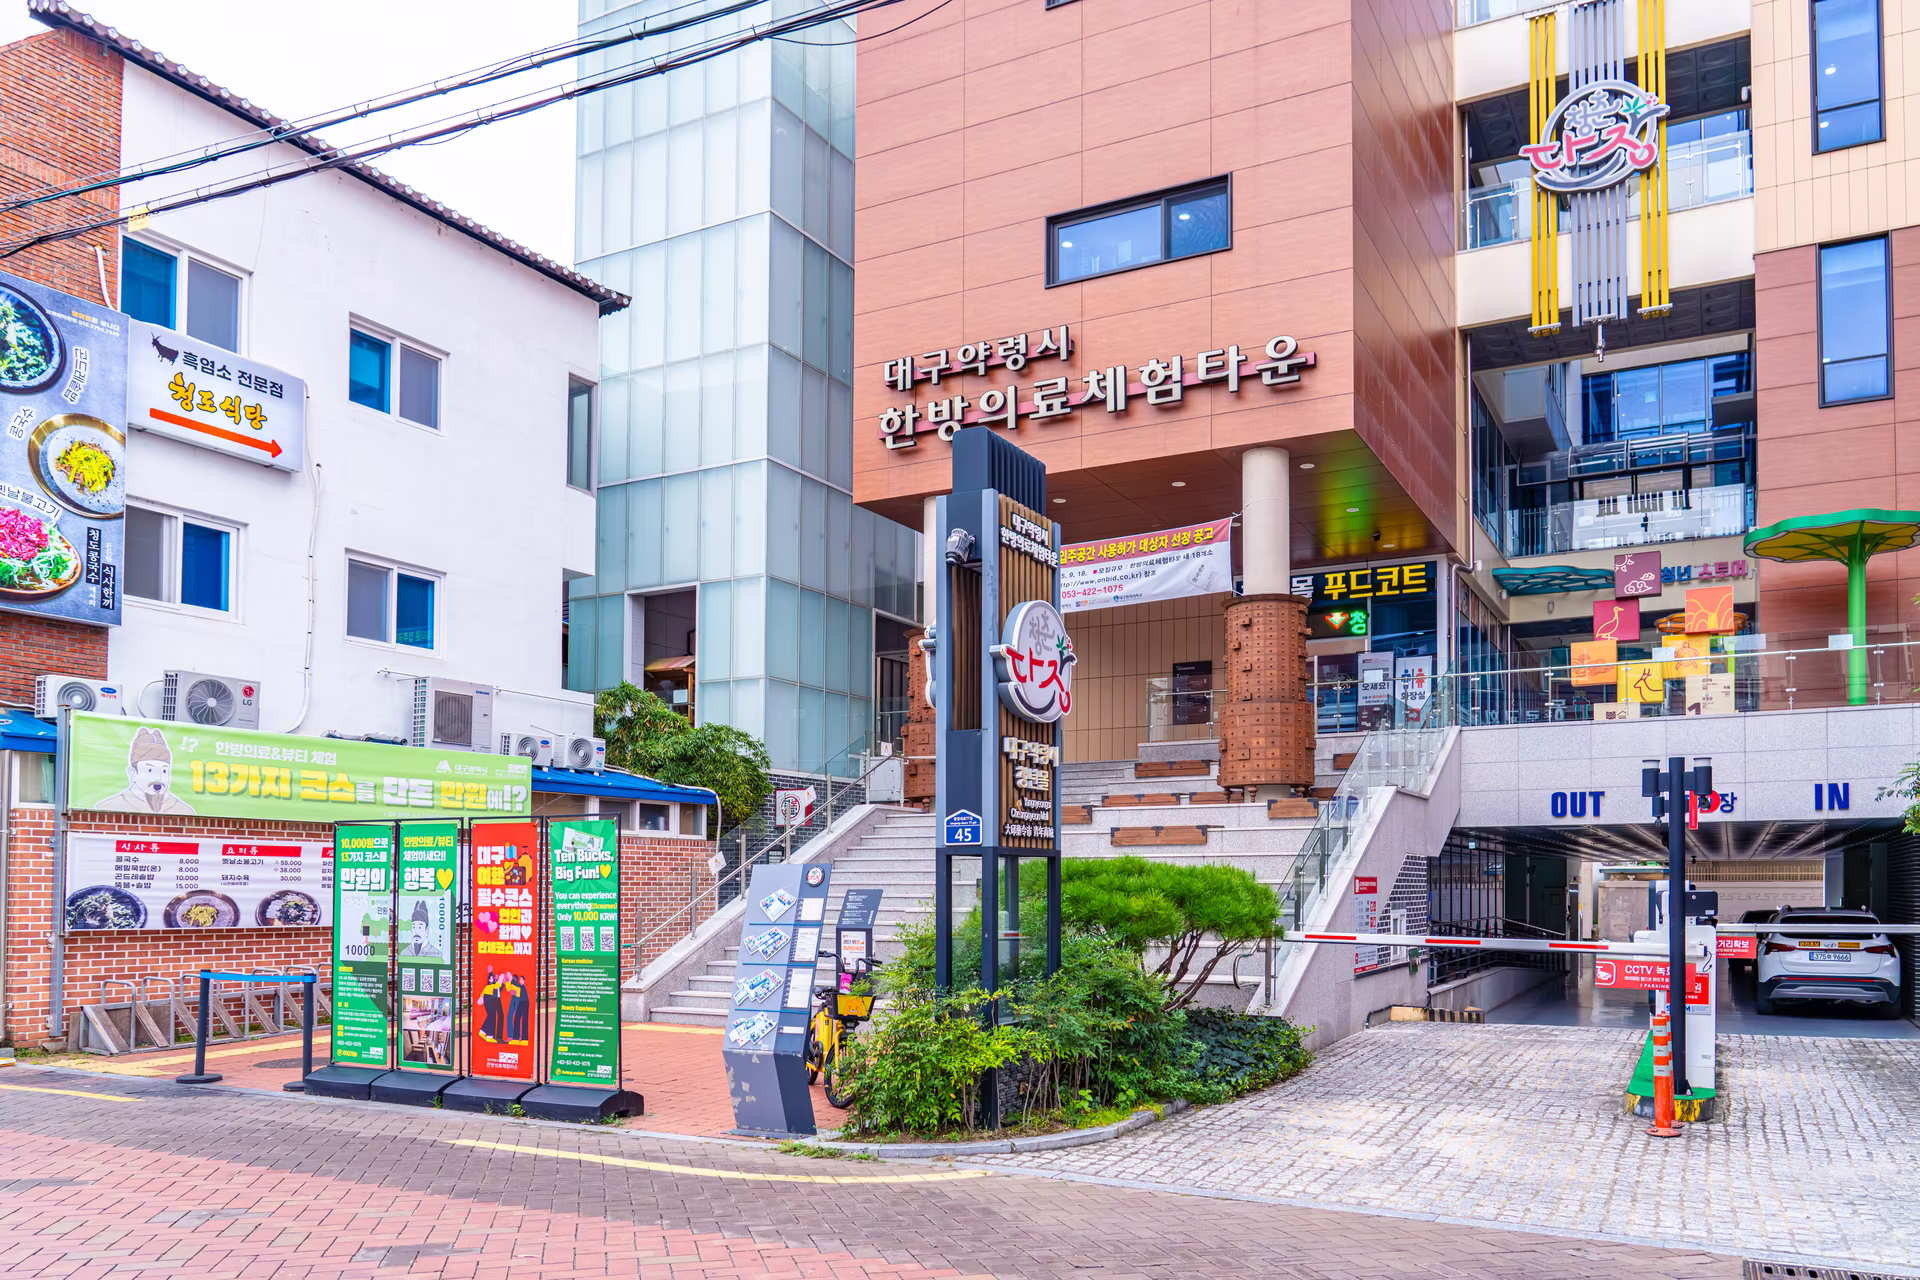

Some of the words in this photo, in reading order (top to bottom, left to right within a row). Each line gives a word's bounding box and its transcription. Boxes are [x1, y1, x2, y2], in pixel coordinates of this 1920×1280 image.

[1565, 90, 1621, 136] 청춘
[1522, 125, 1656, 167] 다정
[883, 324, 1069, 391] 대구약령시
[64, 348, 88, 402] 곤드레솥밥
[182, 351, 232, 381] 흑염소
[237, 369, 283, 399] 전문점
[168, 372, 267, 430] 청도식당
[879, 335, 1307, 450] 한방의료체험타운
[1011, 513, 1048, 546] 대구약령시
[87, 529, 100, 583] 청도콩국수
[1000, 526, 1058, 568] 한방의료체험타운
[1060, 546, 1095, 565] 입주공간
[1098, 540, 1137, 560] 사용허가
[1140, 535, 1168, 553] 대상자
[1172, 531, 1191, 548] 선정
[1194, 528, 1214, 544] 공고
[1144, 570, 1156, 578] 참조
[1324, 564, 1427, 600] 푸드코트
[1662, 565, 1692, 582] 청년
[1698, 560, 1746, 579] 스토어
[102, 566, 114, 610] 식사한끼
[1062, 584, 1124, 598] 053-422-1075
[1029, 610, 1056, 656] 청춘
[1006, 647, 1070, 713] 다정
[1362, 682, 1390, 690] 오세요!
[1401, 691, 1426, 700] 화장실
[180, 736, 198, 752] !?
[216, 742, 308, 763] 한방의료&뷰티
[312, 750, 336, 766] 체험
[1003, 737, 1060, 767] 대구약령시
[454, 764, 488, 772] 대구광역시
[1015, 766, 1050, 791] 청년몰
[190, 760, 292, 798] 13가지
[300, 770, 376, 803] 코스를
[383, 776, 434, 807] 단돈
[440, 780, 528, 812] 만원에!?
[1814, 782, 1850, 811] IN
[1552, 791, 1605, 817] OUT
[341, 838, 388, 849] 10,000원으로
[404, 836, 454, 848] 한방의료/뷰티
[954, 828, 972, 842] 45
[341, 852, 364, 862] 13가지
[365, 852, 387, 862] 코스를
[403, 850, 446, 861] 체험하세요!!
[478, 846, 504, 864] 대구
[554, 850, 576, 862] Ten
[577, 849, 614, 863] Bucks,
[340, 868, 386, 891] 만원의
[404, 867, 436, 891] 행복
[478, 866, 505, 885] 여행
[555, 866, 574, 882] Big
[576, 865, 600, 879] Fun!
[478, 888, 532, 907] 필수코스
[581, 891, 617, 900] experience
[499, 908, 532, 924] 연인과
[557, 913, 572, 922] Only
[574, 911, 598, 922] 10,000
[600, 912, 617, 921] KRW!
[499, 925, 521, 940] 함께
[345, 945, 375, 956] 10000
[478, 941, 532, 955] 단체코스까지
[1625, 965, 1654, 975] CCTV
